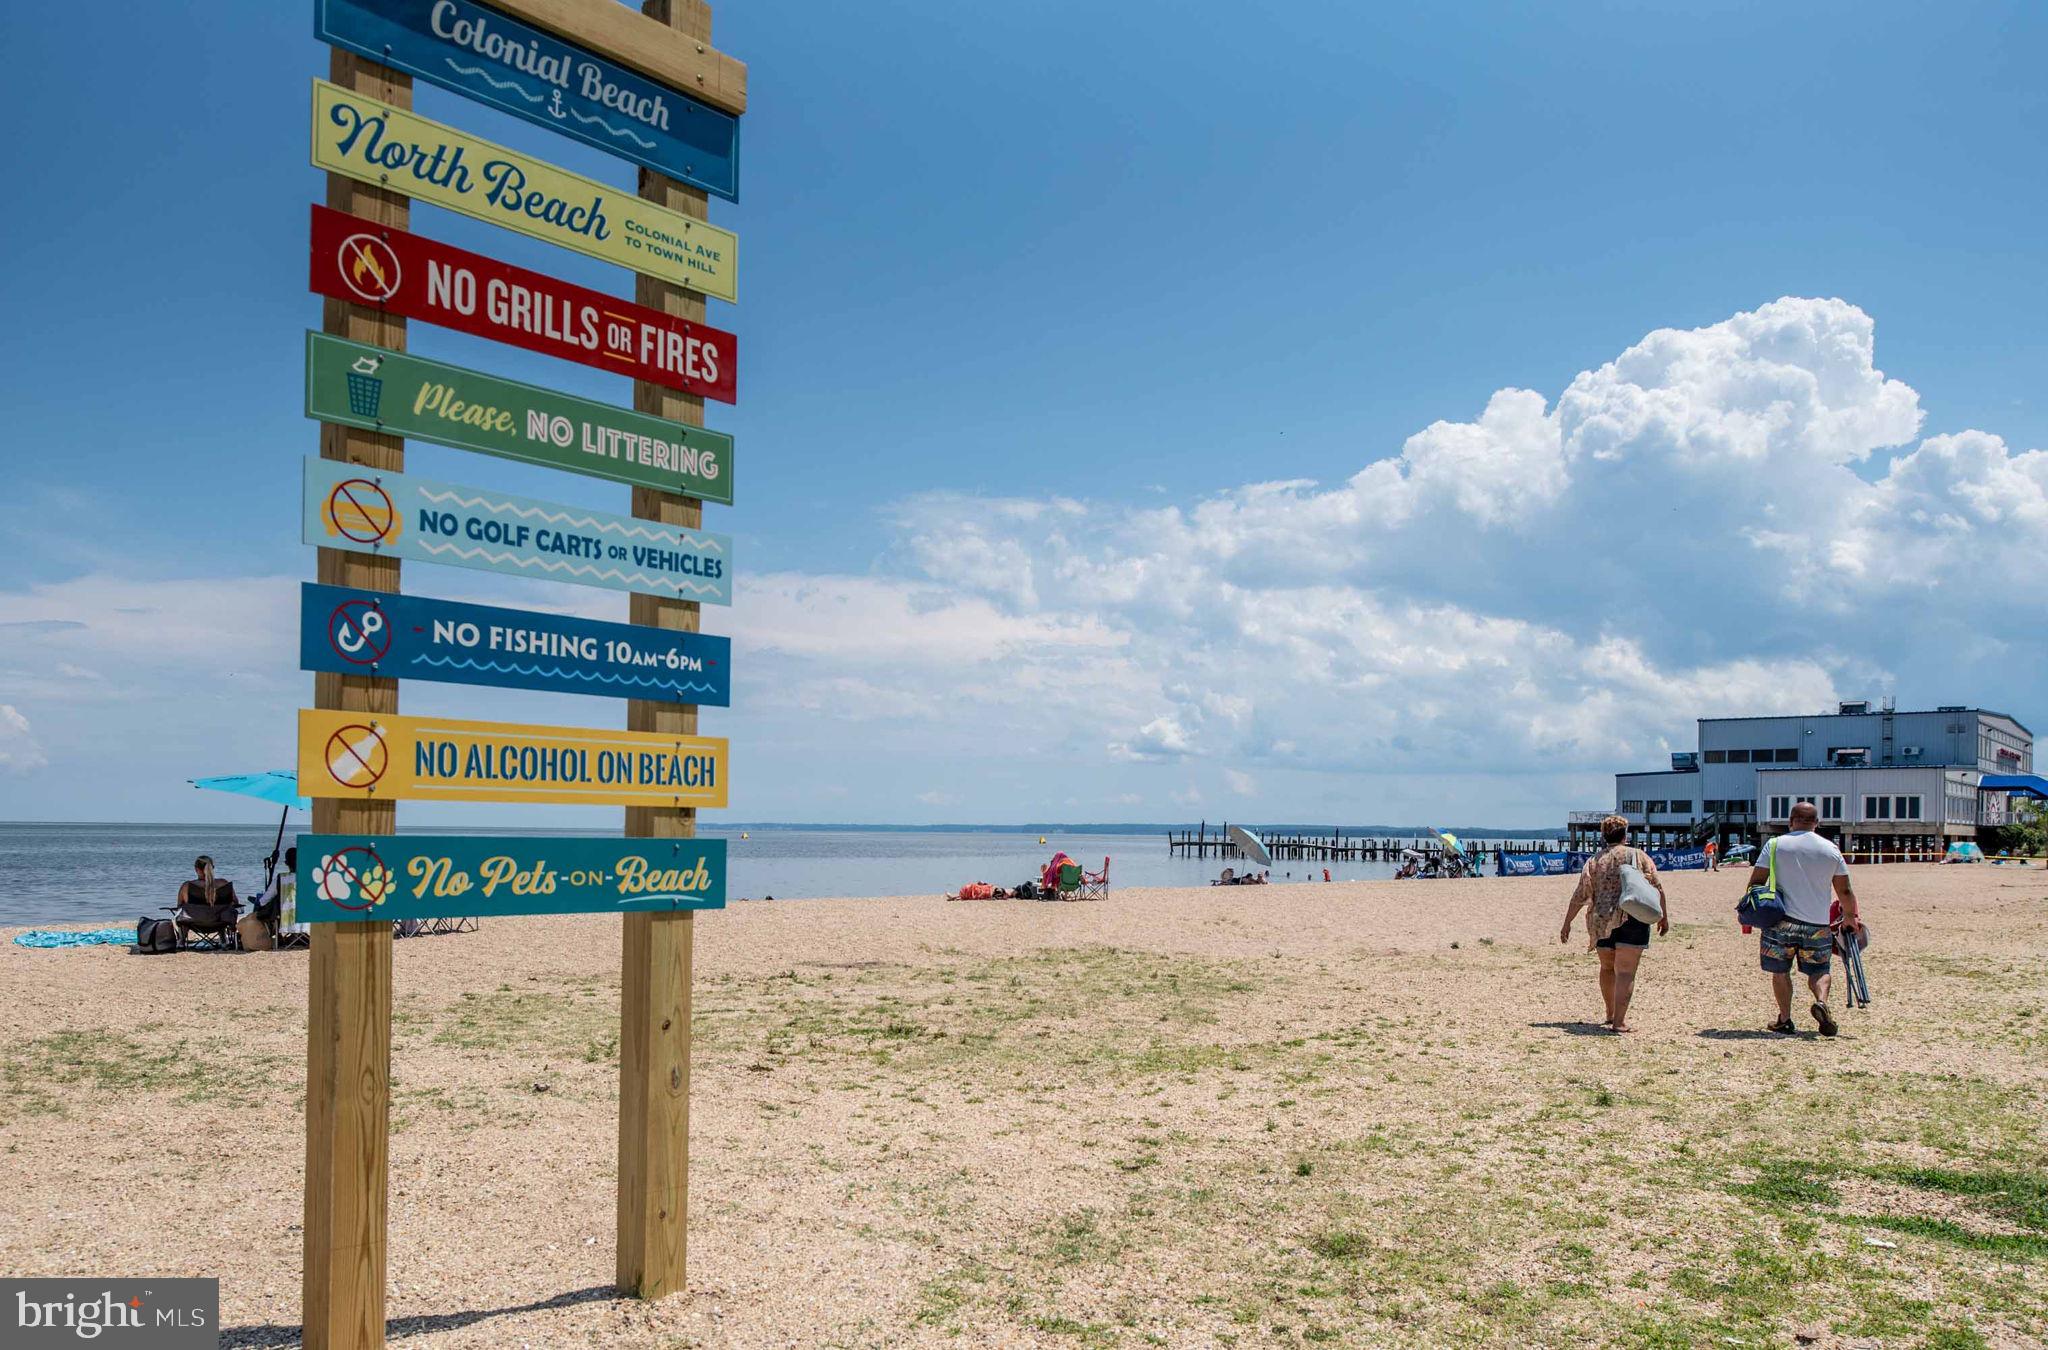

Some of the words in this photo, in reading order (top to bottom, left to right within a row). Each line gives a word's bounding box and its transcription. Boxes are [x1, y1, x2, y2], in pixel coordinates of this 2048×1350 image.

[430, 0, 572, 89] Colonial
[578, 63, 670, 131] Beach
[330, 103, 474, 194] North
[483, 160, 610, 241] Beach
[624, 235, 642, 250] TO
[646, 243, 684, 266] TOWN
[687, 255, 716, 275] HILL
[625, 219, 692, 251] COLONIAL
[697, 243, 721, 262] AVE
[427, 259, 476, 316] NO
[487, 278, 599, 350] GRILLS
[607, 325, 632, 353] OR
[640, 324, 718, 383] FIRES
[414, 381, 517, 437] Please,
[527, 409, 573, 447] NO
[582, 421, 718, 480] LITTERING
[419, 509, 458, 536] NO
[465, 518, 529, 548] GOLF
[536, 529, 602, 560] CARTS
[608, 545, 627, 562] OR
[633, 545, 722, 578] VEHICLES
[433, 619, 480, 647] NO
[489, 626, 598, 661] FISHING
[415, 740, 458, 778] NO
[464, 744, 592, 784] ALCOHOL
[597, 750, 632, 784] ON
[638, 753, 715, 788] BEACH
[407, 855, 473, 899] No
[479, 855, 557, 897] Pets
[614, 855, 713, 895] Beach
